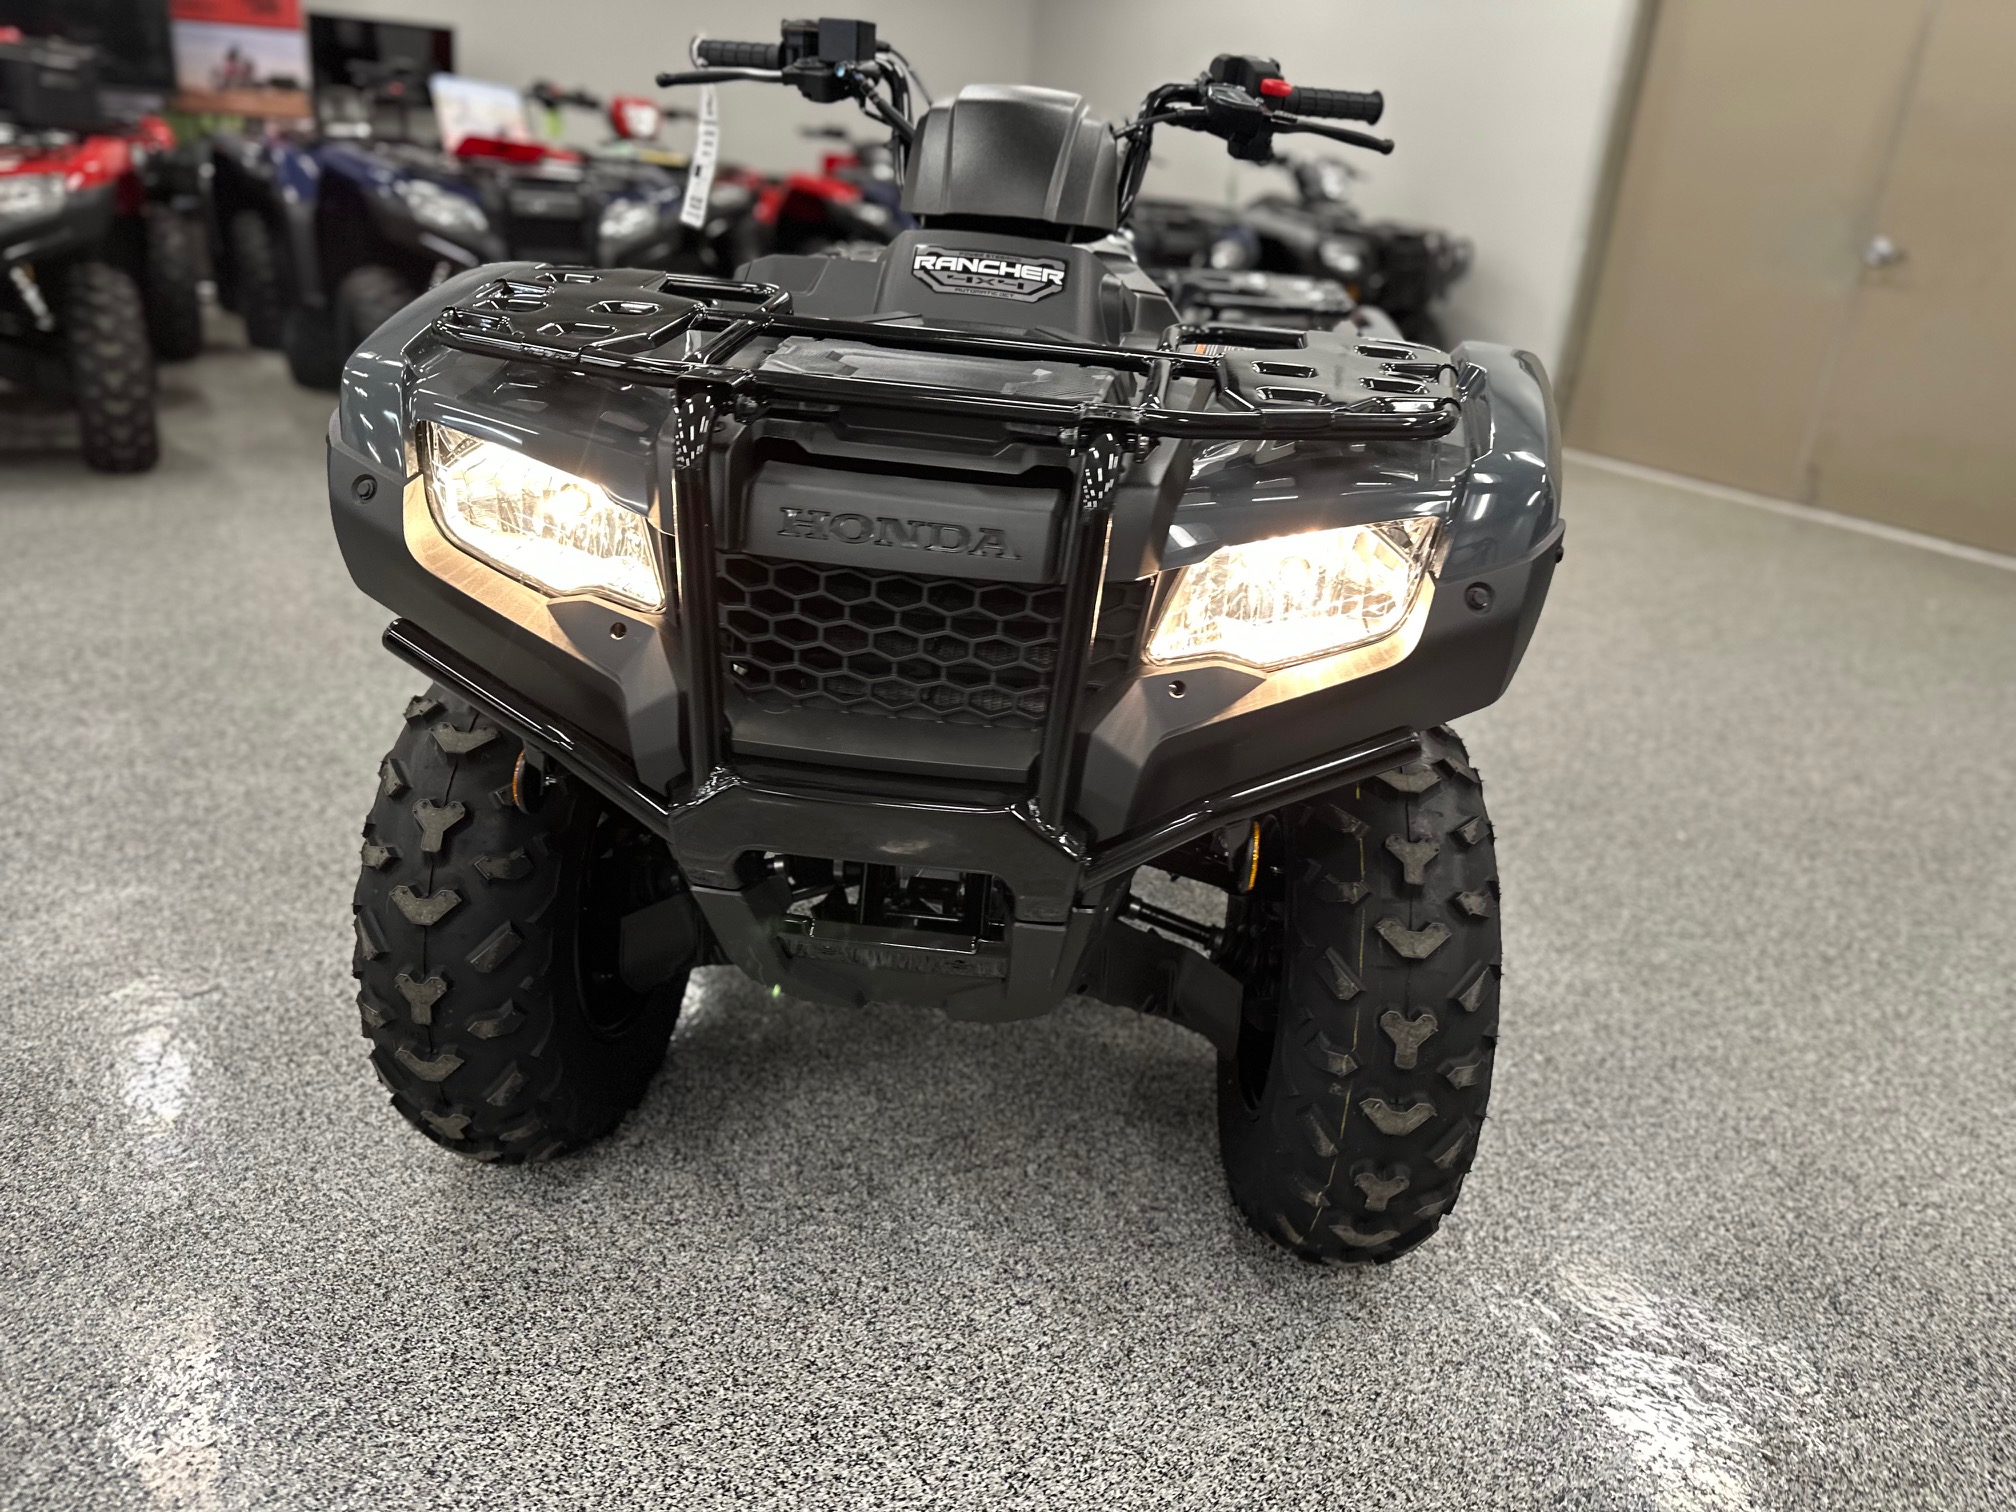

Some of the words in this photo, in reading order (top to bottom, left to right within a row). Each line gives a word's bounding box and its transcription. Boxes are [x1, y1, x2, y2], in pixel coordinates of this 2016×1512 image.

[985, 253, 1022, 262] STEERING
[913, 255, 1065, 285] RANCHER
[954, 287, 998, 296] AUTOMATIC
[777, 506, 1022, 560] HONDA
